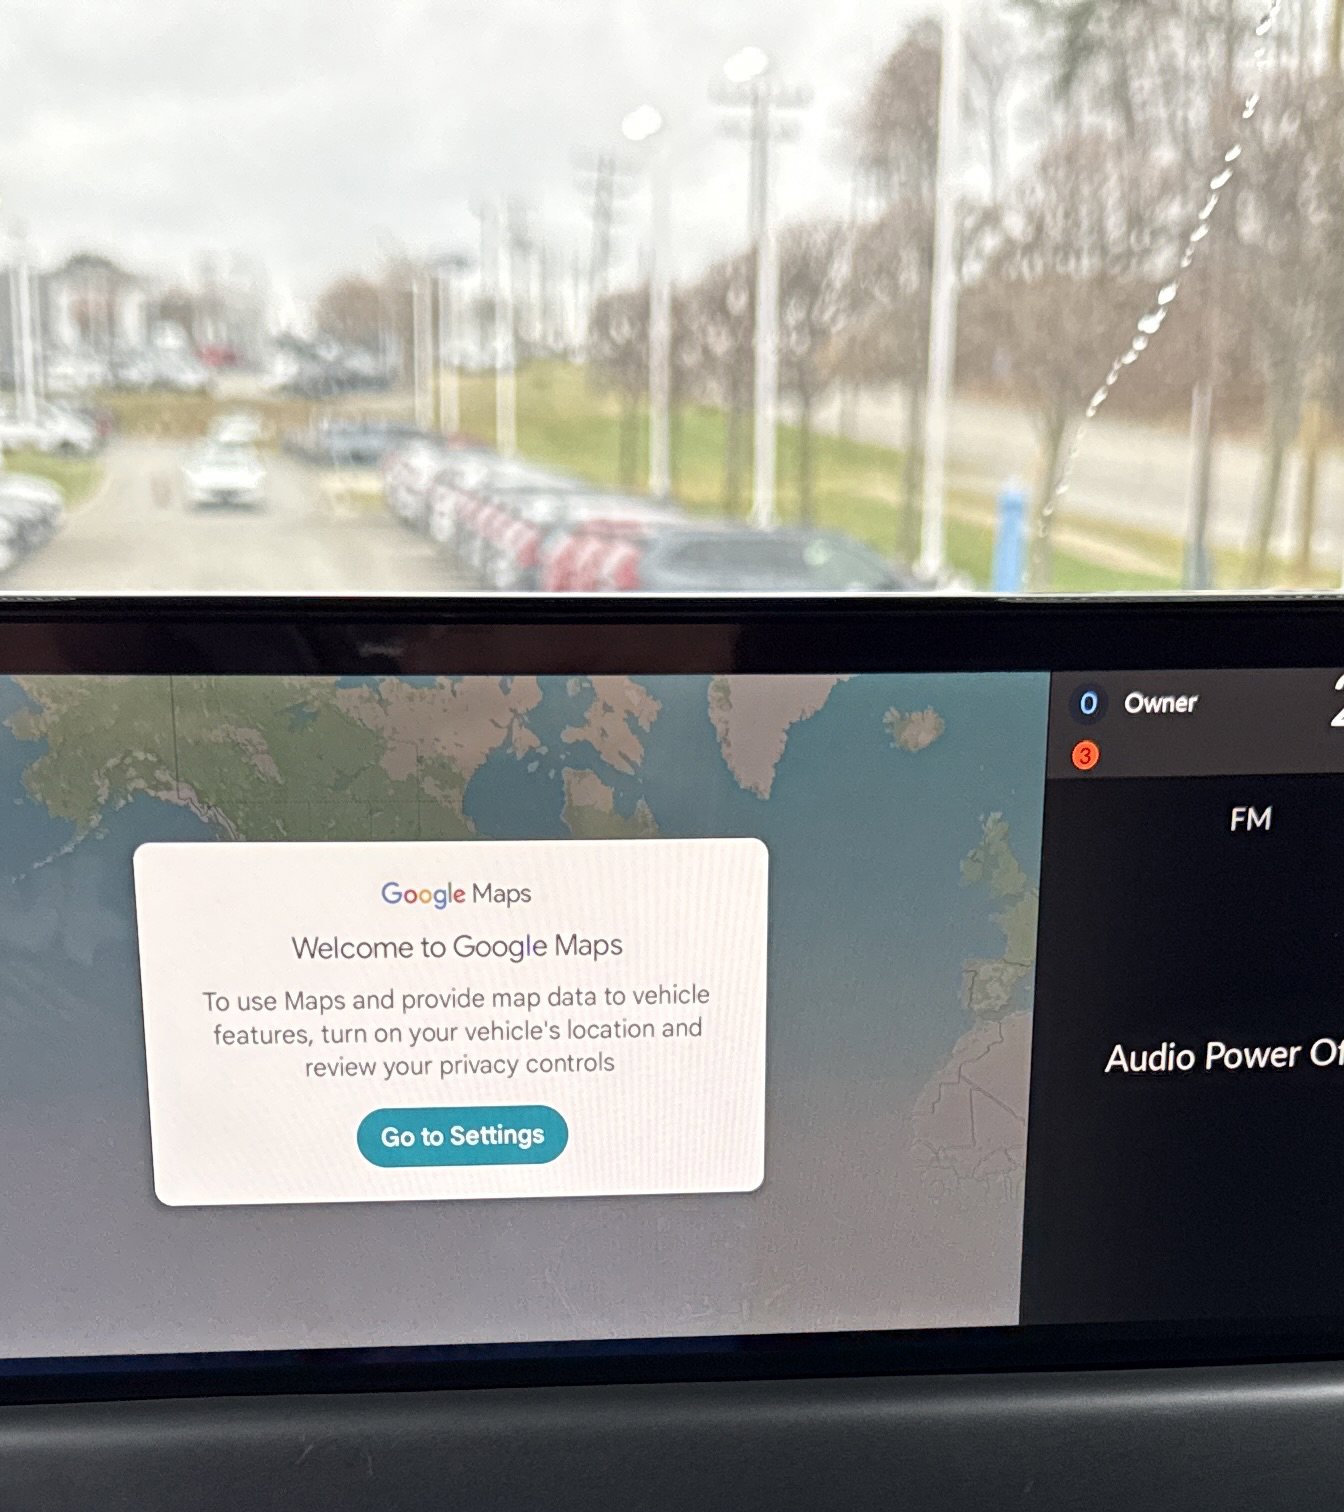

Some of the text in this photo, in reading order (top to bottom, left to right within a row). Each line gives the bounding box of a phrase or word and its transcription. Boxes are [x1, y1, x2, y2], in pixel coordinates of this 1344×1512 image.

[1124, 691, 1199, 714] Owner
[1079, 747, 1091, 765] 3
[1230, 806, 1272, 832] FM
[381, 881, 532, 911] Google Maps
[291, 933, 623, 964] Welcome to Google Maps
[202, 983, 710, 1016] To use Maps and provide map data to vehicle
[213, 1015, 702, 1048] features, turn on your vehicle's location and
[305, 1051, 615, 1082] review your privacy controls
[1104, 1041, 1196, 1073] Audio
[1205, 1041, 1303, 1070] Power
[381, 1123, 545, 1150] Go to Settings
